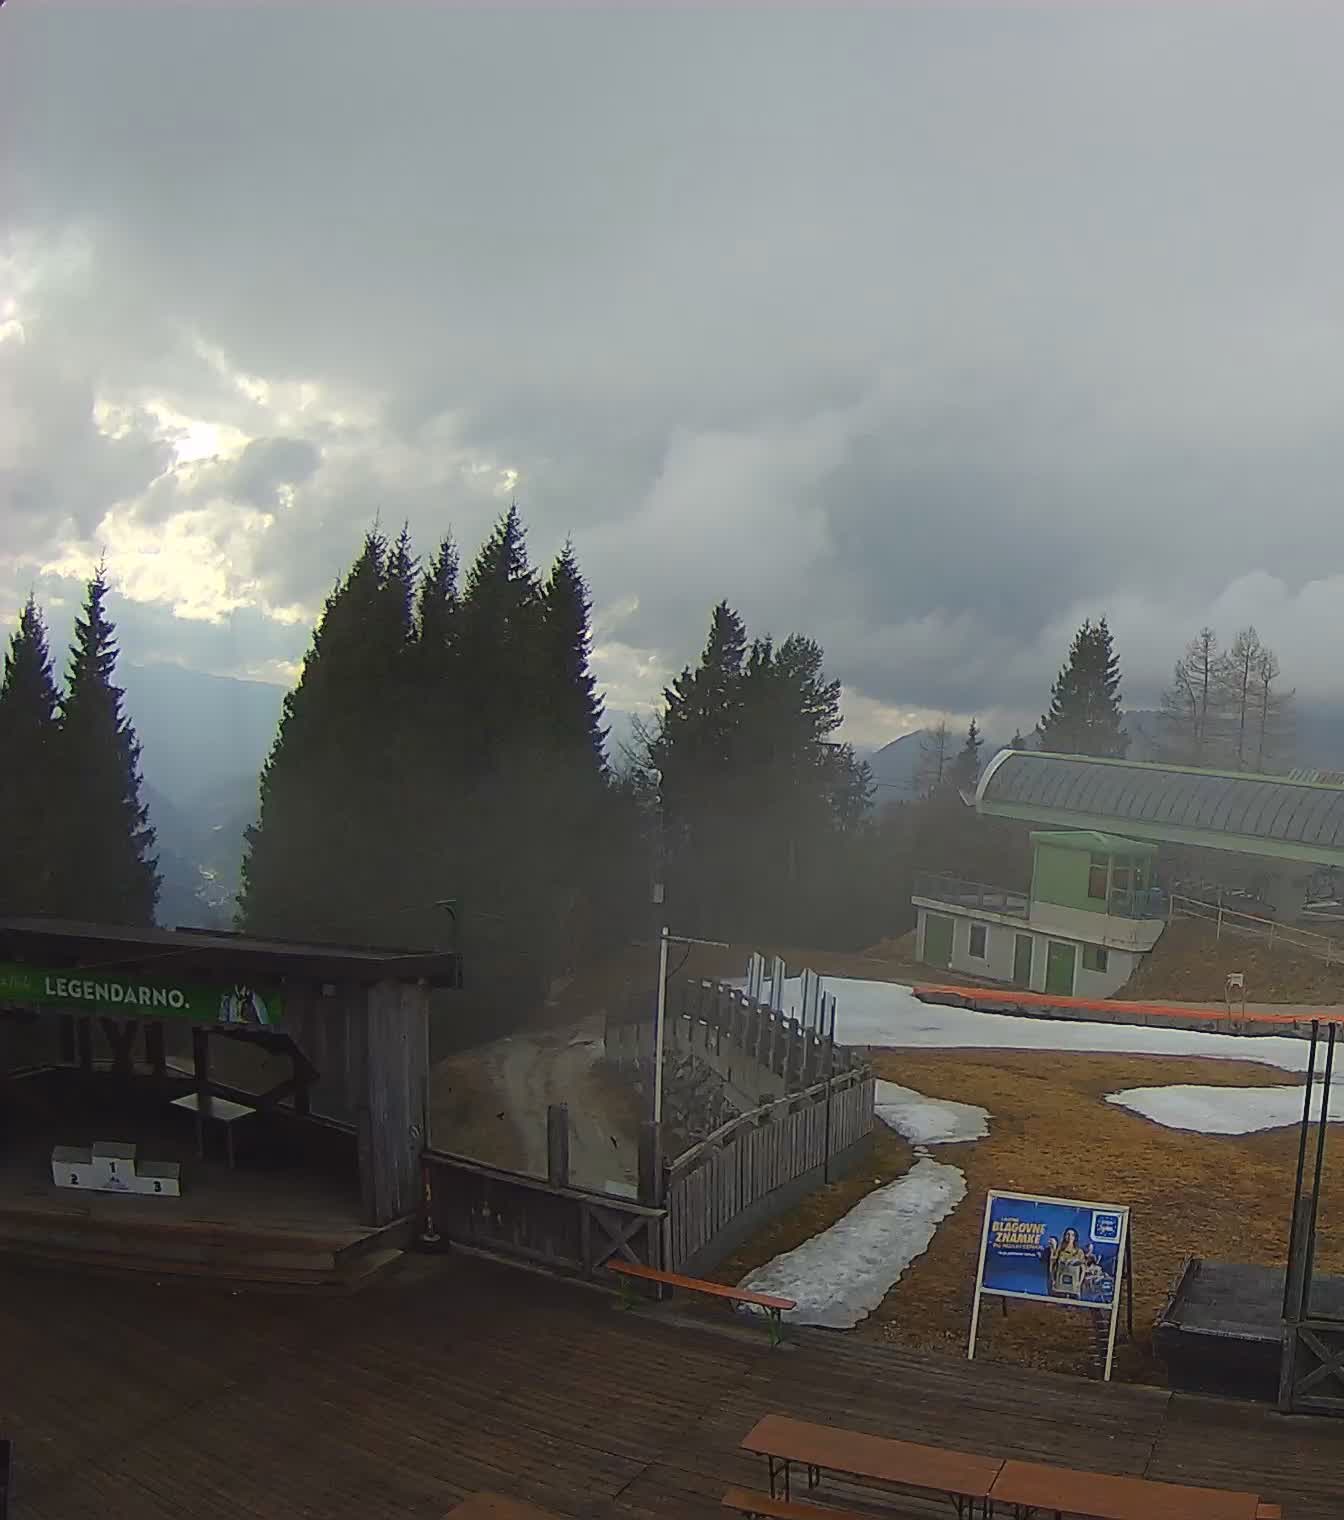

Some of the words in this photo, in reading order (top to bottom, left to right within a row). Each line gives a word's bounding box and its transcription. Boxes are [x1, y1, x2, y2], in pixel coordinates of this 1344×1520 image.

[44, 976, 191, 1009] LEGENDARNO.
[109, 1161, 116, 1174] 1
[70, 1174, 79, 1186] 2
[153, 1180, 162, 1193] 3
[992, 1220, 1047, 1235] BLAGOVNE
[995, 1231, 1042, 1244] ZNAMKE
